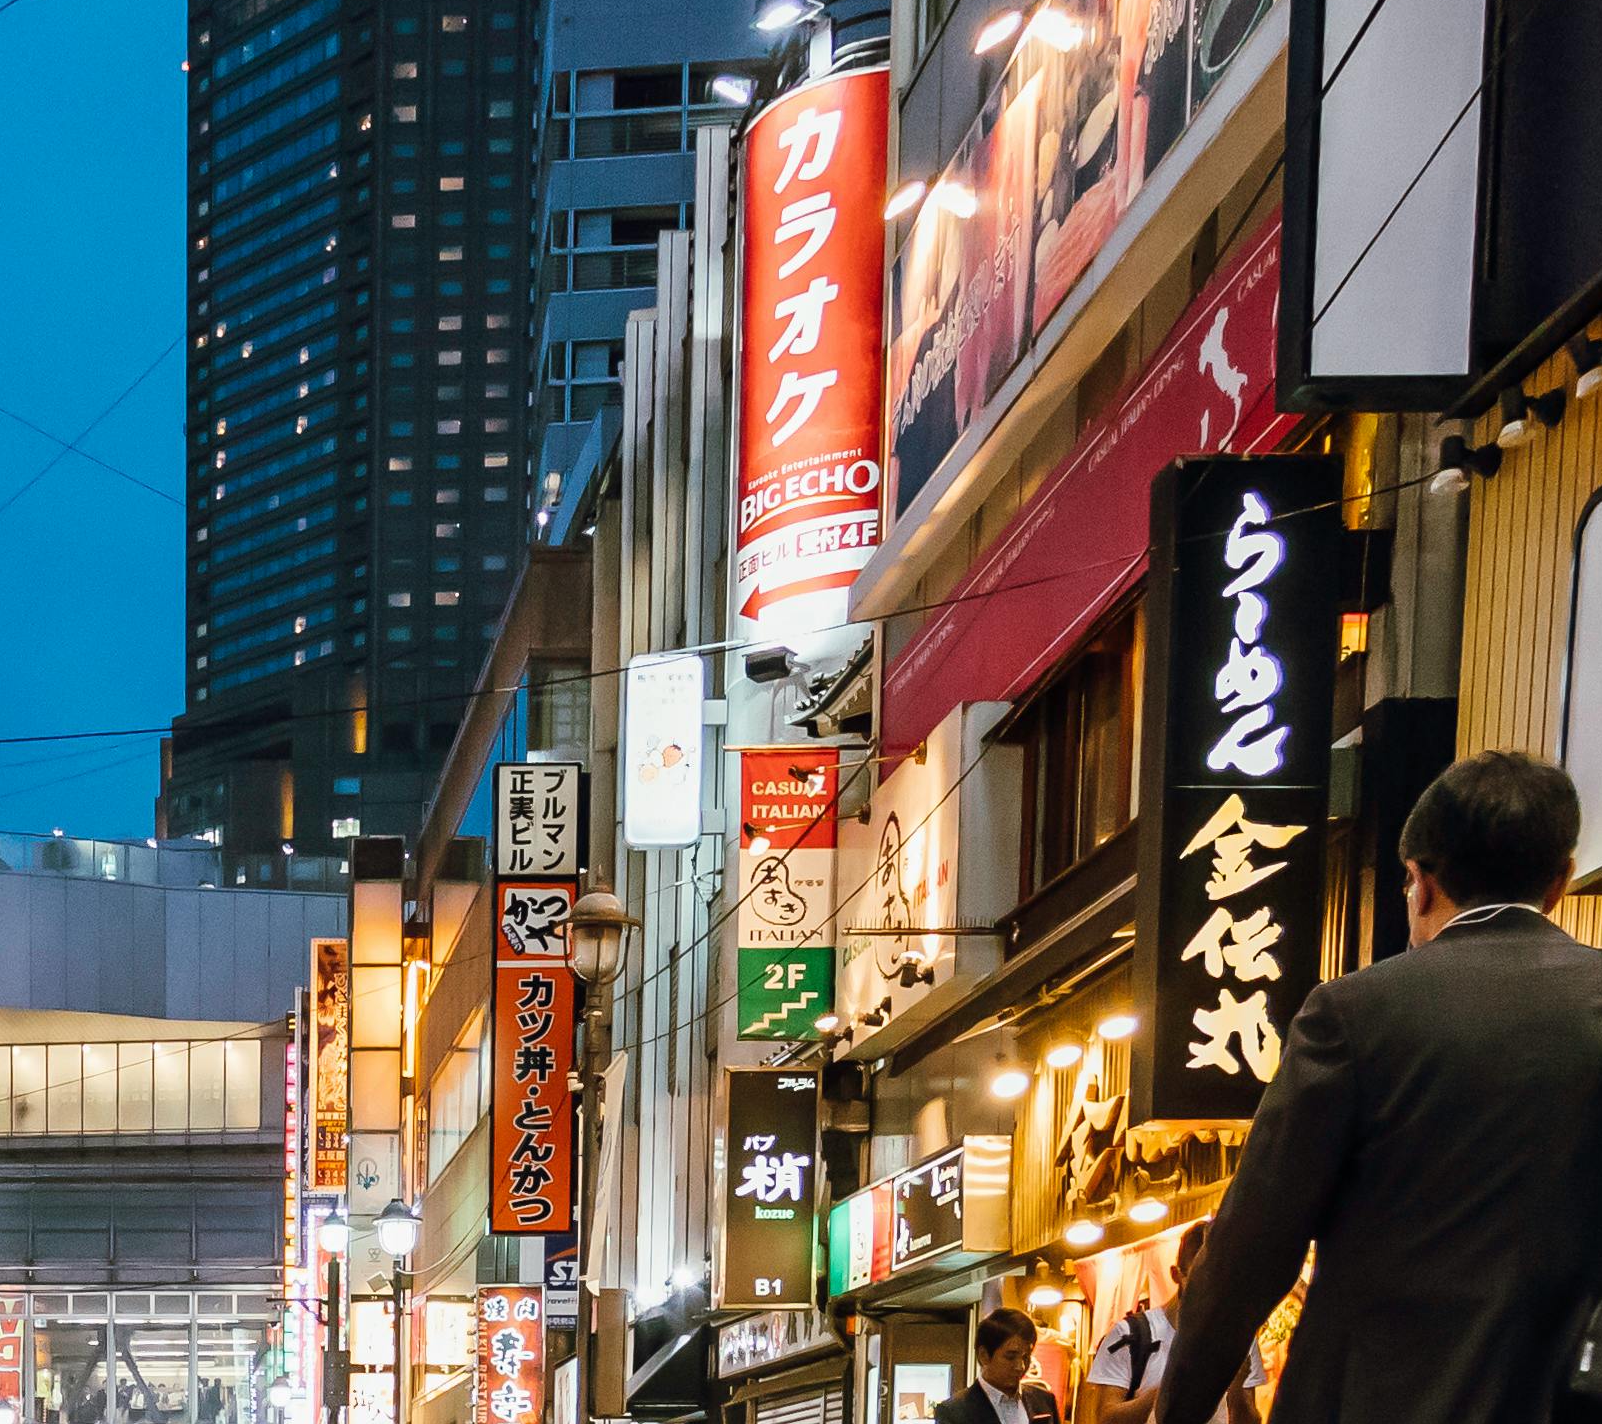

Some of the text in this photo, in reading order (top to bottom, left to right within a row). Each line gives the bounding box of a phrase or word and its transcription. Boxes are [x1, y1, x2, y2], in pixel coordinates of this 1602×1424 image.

[765, 106, 843, 448] カラオケ
[781, 447, 863, 474] Entertainment
[740, 459, 880, 534] BIG ECHO
[1205, 490, 1292, 776] らーめん
[542, 768, 567, 871] ブルマン
[751, 780, 828, 800] CASUAL
[751, 803, 827, 821] ITALIAN
[509, 769, 535, 872] 正実ビル
[503, 892, 568, 952] かつや
[749, 928, 825, 943] ITALIAN
[1179, 793, 1308, 1083] 金伝丸
[763, 964, 808, 992] 2F
[509, 973, 556, 1226] カツ丼・とんかつ
[755, 1206, 795, 1221] kozue
[755, 1278, 782, 1297] B1
